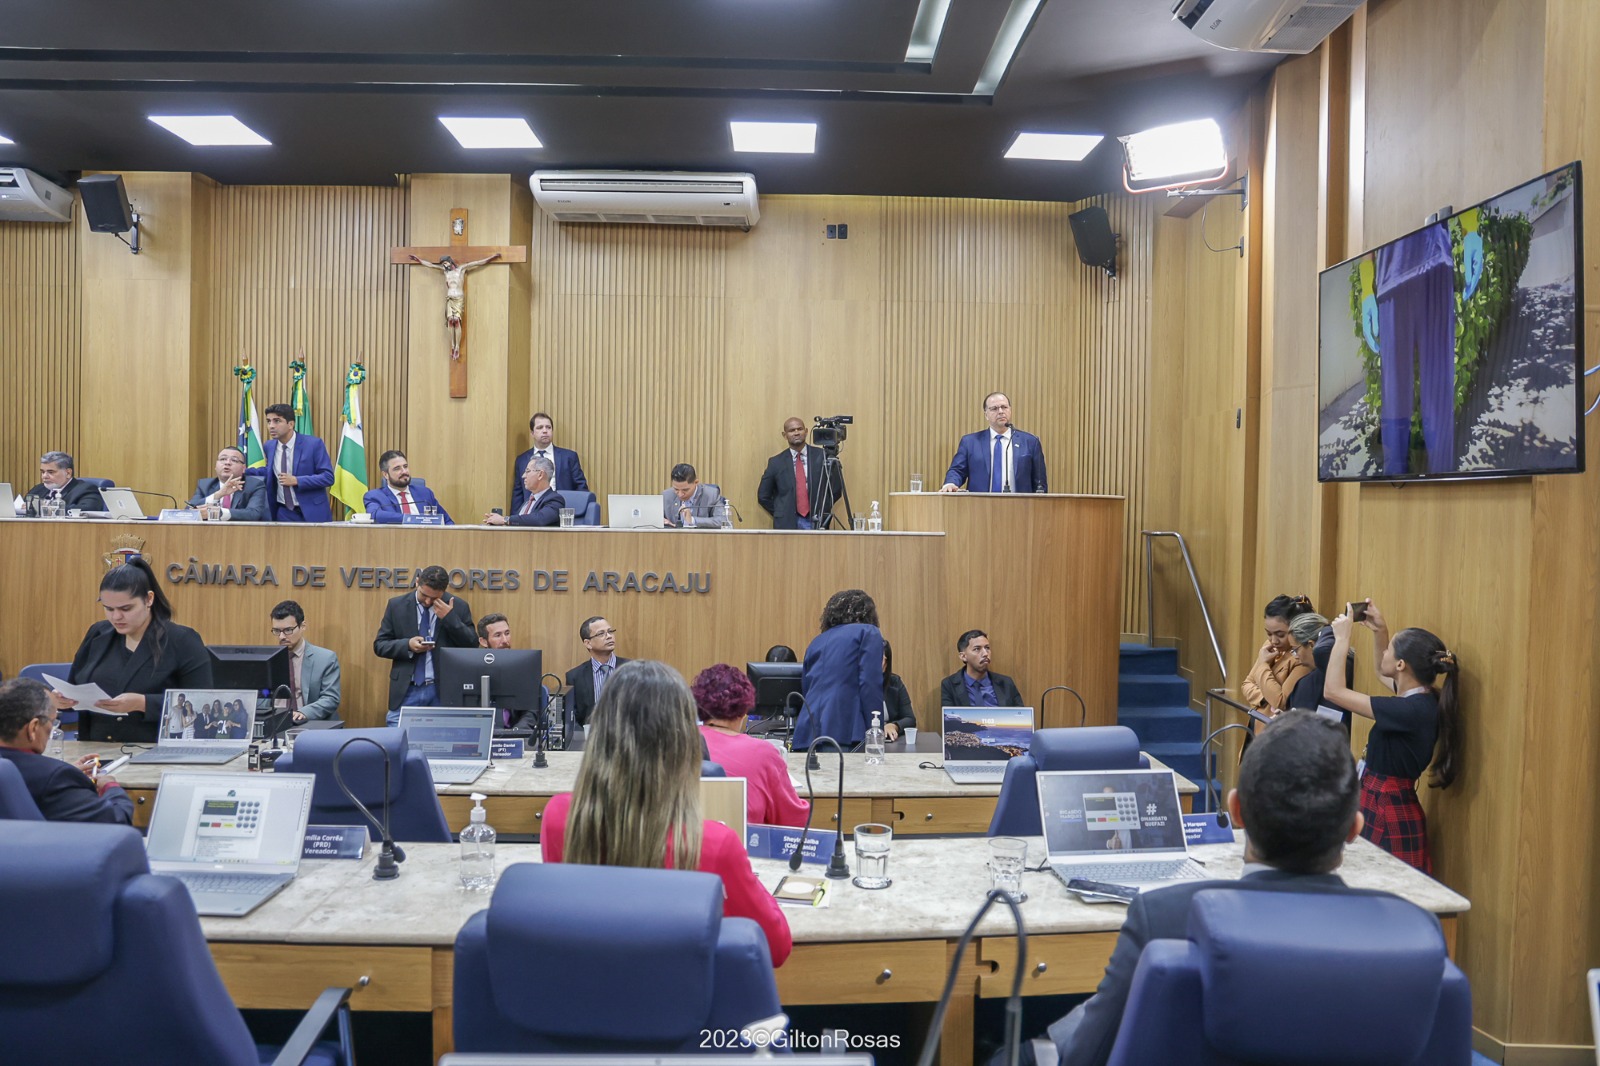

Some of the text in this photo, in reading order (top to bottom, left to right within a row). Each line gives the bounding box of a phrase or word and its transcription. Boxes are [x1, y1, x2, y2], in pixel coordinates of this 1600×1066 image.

[166, 557, 712, 593] CÂMARA DE VEREAORES DE ARACAJU
